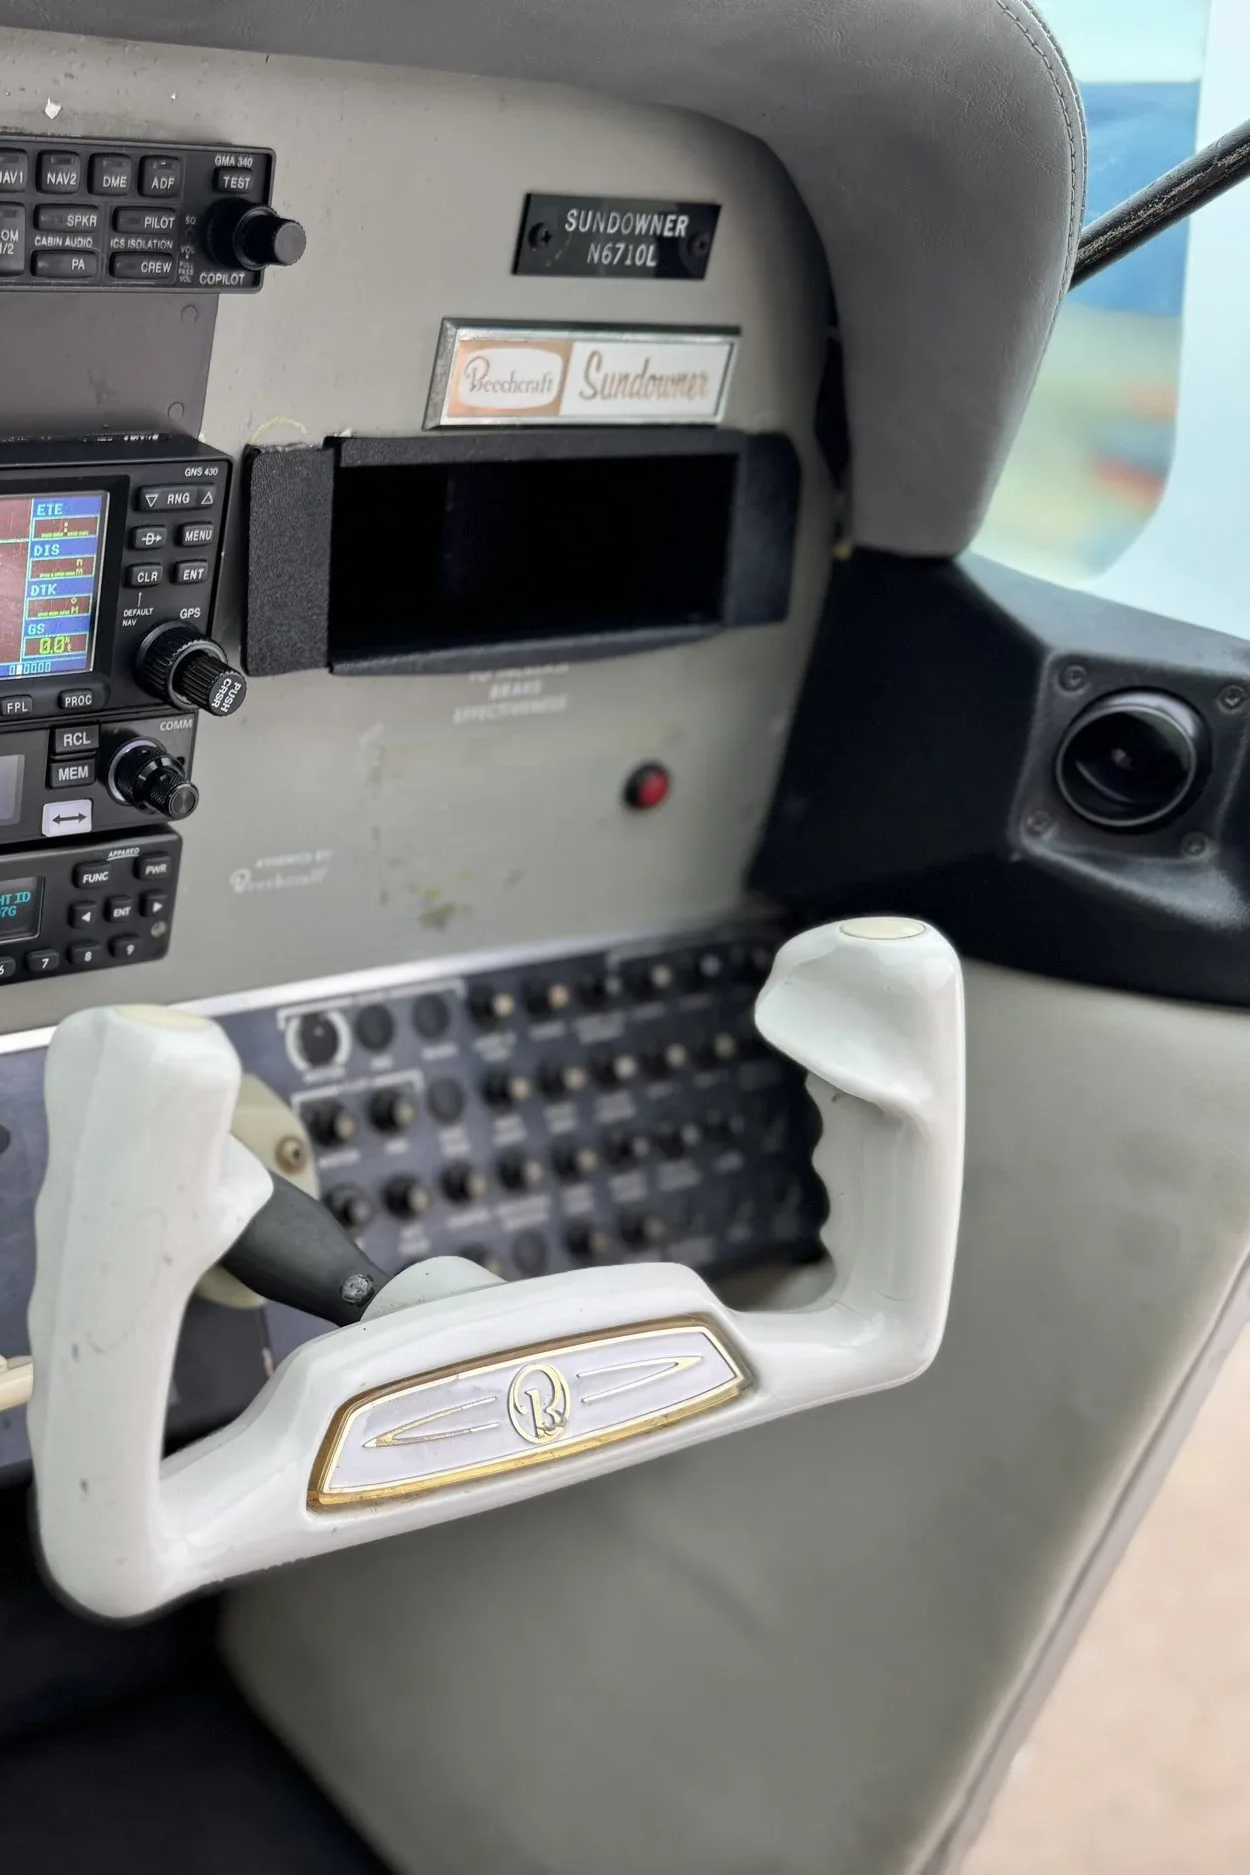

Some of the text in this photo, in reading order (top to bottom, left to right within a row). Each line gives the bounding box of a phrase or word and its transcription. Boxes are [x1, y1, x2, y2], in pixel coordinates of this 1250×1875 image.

[214, 155, 254, 167] GMA 340
[46, 172, 78, 186] NAV2
[102, 175, 128, 188] DME
[151, 177, 175, 190] ADF
[222, 175, 252, 190] TEST
[66, 213, 98, 228] SPKR
[144, 217, 175, 230] PILOT
[564, 208, 690, 238] SUNDOWNER
[34, 236, 94, 250] CABIN AUDIO
[127, 239, 174, 250] ISOLATION
[586, 243, 659, 267] N6710L
[70, 258, 86, 270] PA
[140, 260, 172, 275] CREW
[199, 271, 246, 286] COPILOT
[464, 350, 711, 401] Beechcraft Sundowner
[184, 466, 219, 477] GNS 430
[166, 491, 190, 505] RNG
[36, 503, 63, 516] ETE
[184, 529, 212, 542] MENU
[33, 544, 61, 556] DIS
[136, 571, 159, 584] CLR
[182, 568, 204, 581] ENT
[30, 583, 57, 596] DTK
[123, 608, 154, 618] DEFAULT
[179, 608, 201, 620] GPS
[64, 694, 92, 707] PROC
[6, 701, 29, 714] FPL
[160, 718, 193, 732] COMM
[63, 732, 91, 747] RCL
[58, 766, 89, 783] MEM
[144, 863, 168, 876] PWR
[82, 871, 109, 884] FUNC
[13, 891, 32, 904] ID
[112, 907, 132, 919] ENT
